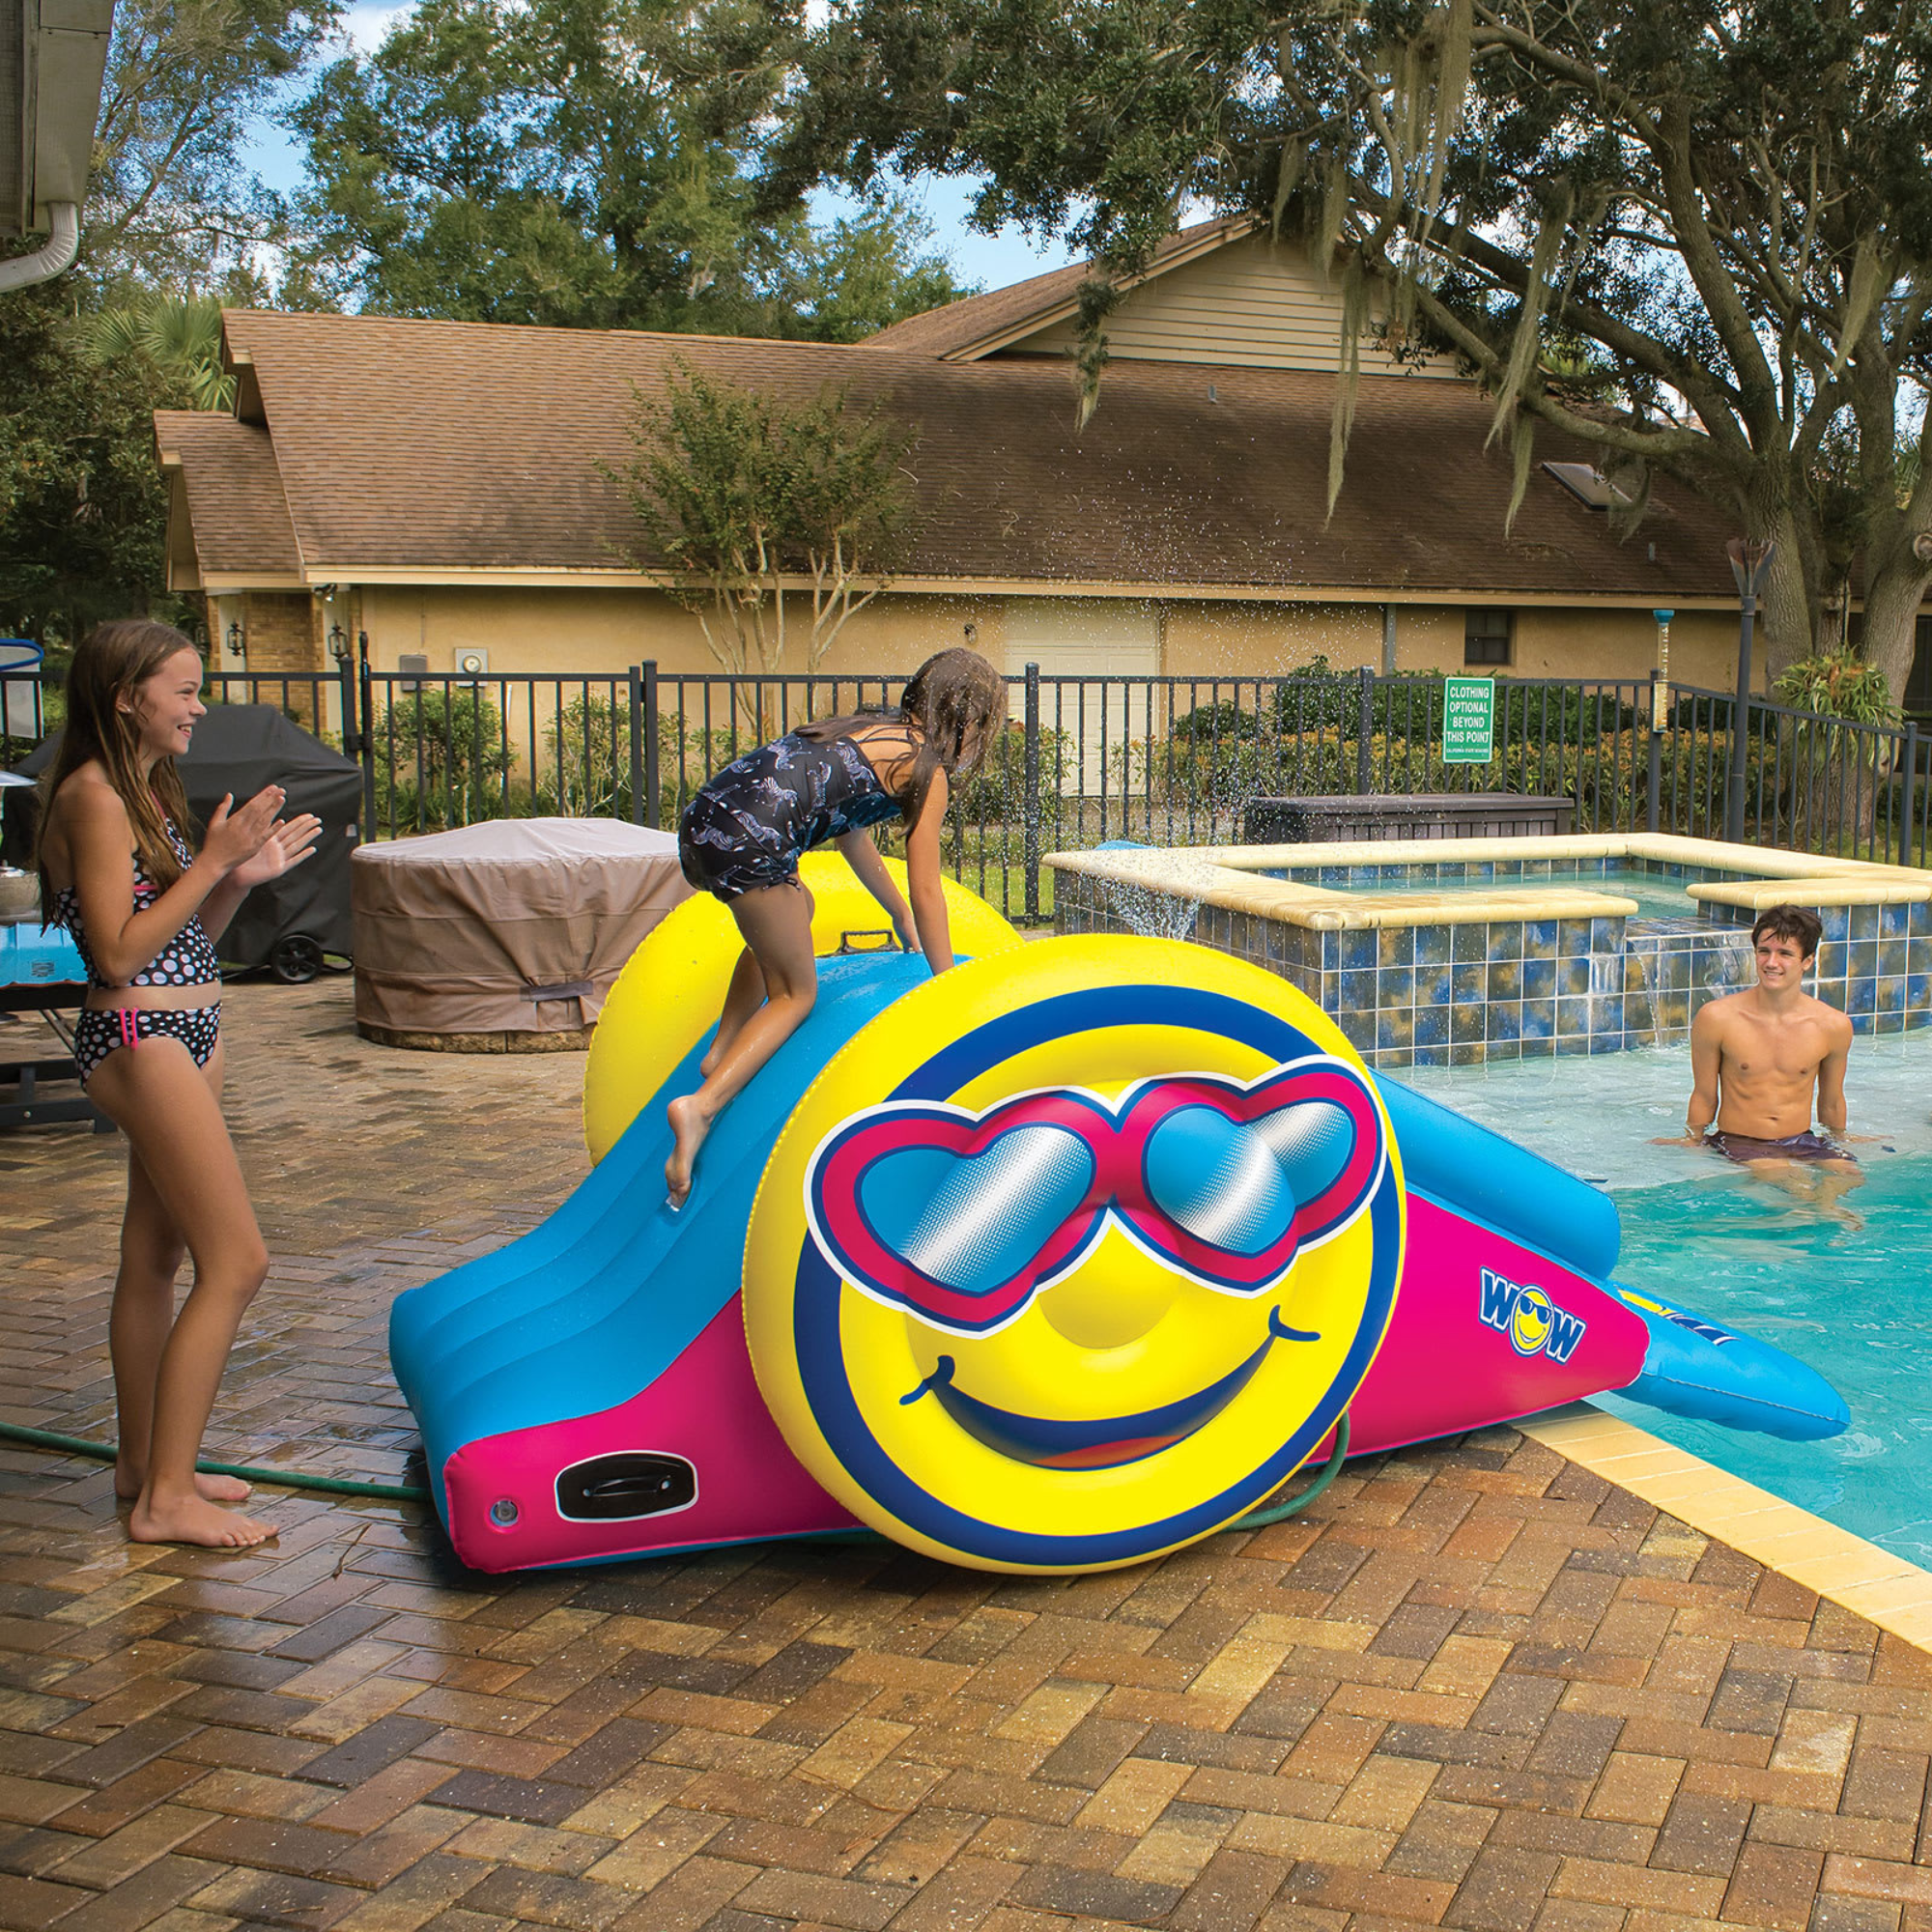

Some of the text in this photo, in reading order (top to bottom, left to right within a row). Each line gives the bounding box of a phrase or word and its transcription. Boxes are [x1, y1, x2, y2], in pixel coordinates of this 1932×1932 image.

[1449, 686, 1490, 698] CLOTHING
[1449, 701, 1489, 713] OPTIONAL
[1452, 717, 1485, 728] BEYOND
[1447, 731, 1490, 743] THIS POINT
[1479, 1265, 1587, 1365] WOW
